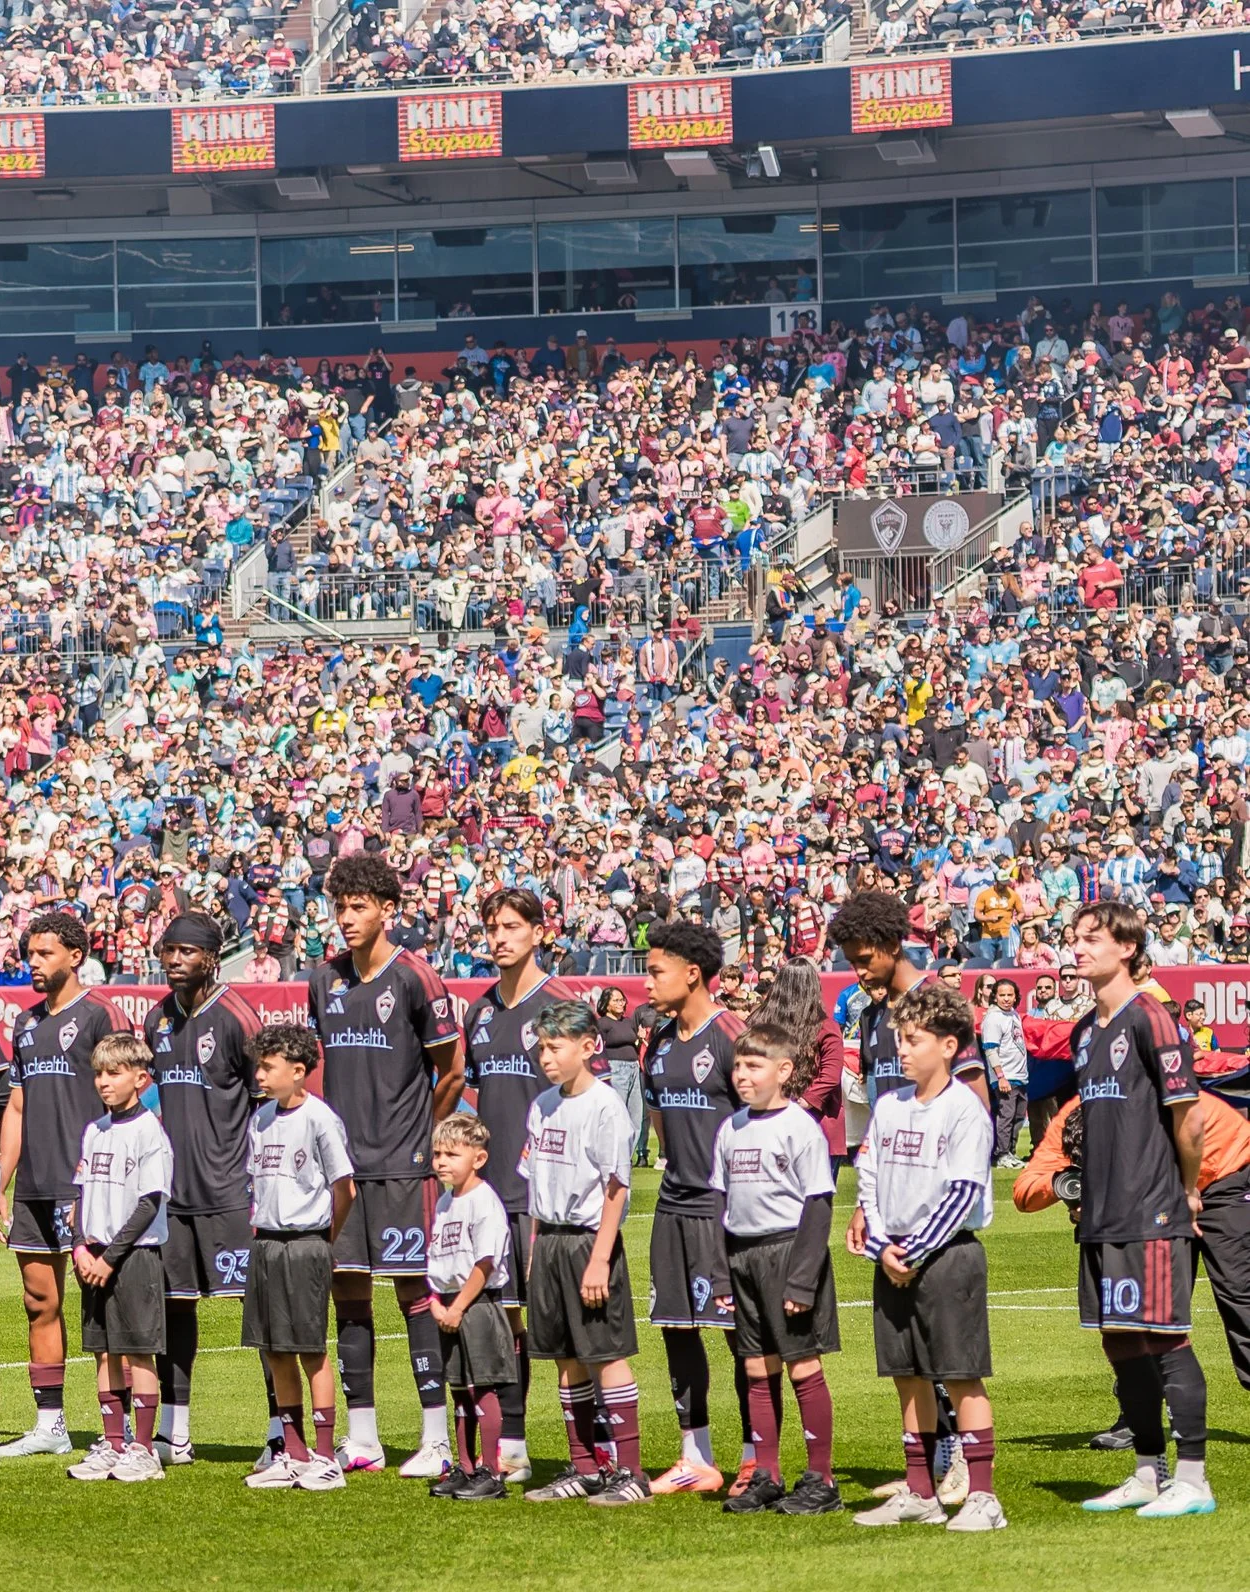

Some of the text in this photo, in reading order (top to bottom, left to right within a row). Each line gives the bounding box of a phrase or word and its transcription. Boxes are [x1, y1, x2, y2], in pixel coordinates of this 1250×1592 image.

[859, 67, 944, 100] KING
[407, 99, 493, 129] KING
[636, 86, 724, 117] KING
[858, 100, 945, 128] Soopers
[181, 111, 267, 141] KING
[637, 117, 726, 144] Soopers
[180, 141, 268, 169] Soopers
[407, 129, 495, 157] Soopers
[1194, 982, 1250, 1025] DIC
[331, 1027, 387, 1046] uchealth
[382, 1227, 425, 1262] 22
[216, 1250, 250, 1284] 93
[1101, 1278, 1139, 1314] 10
